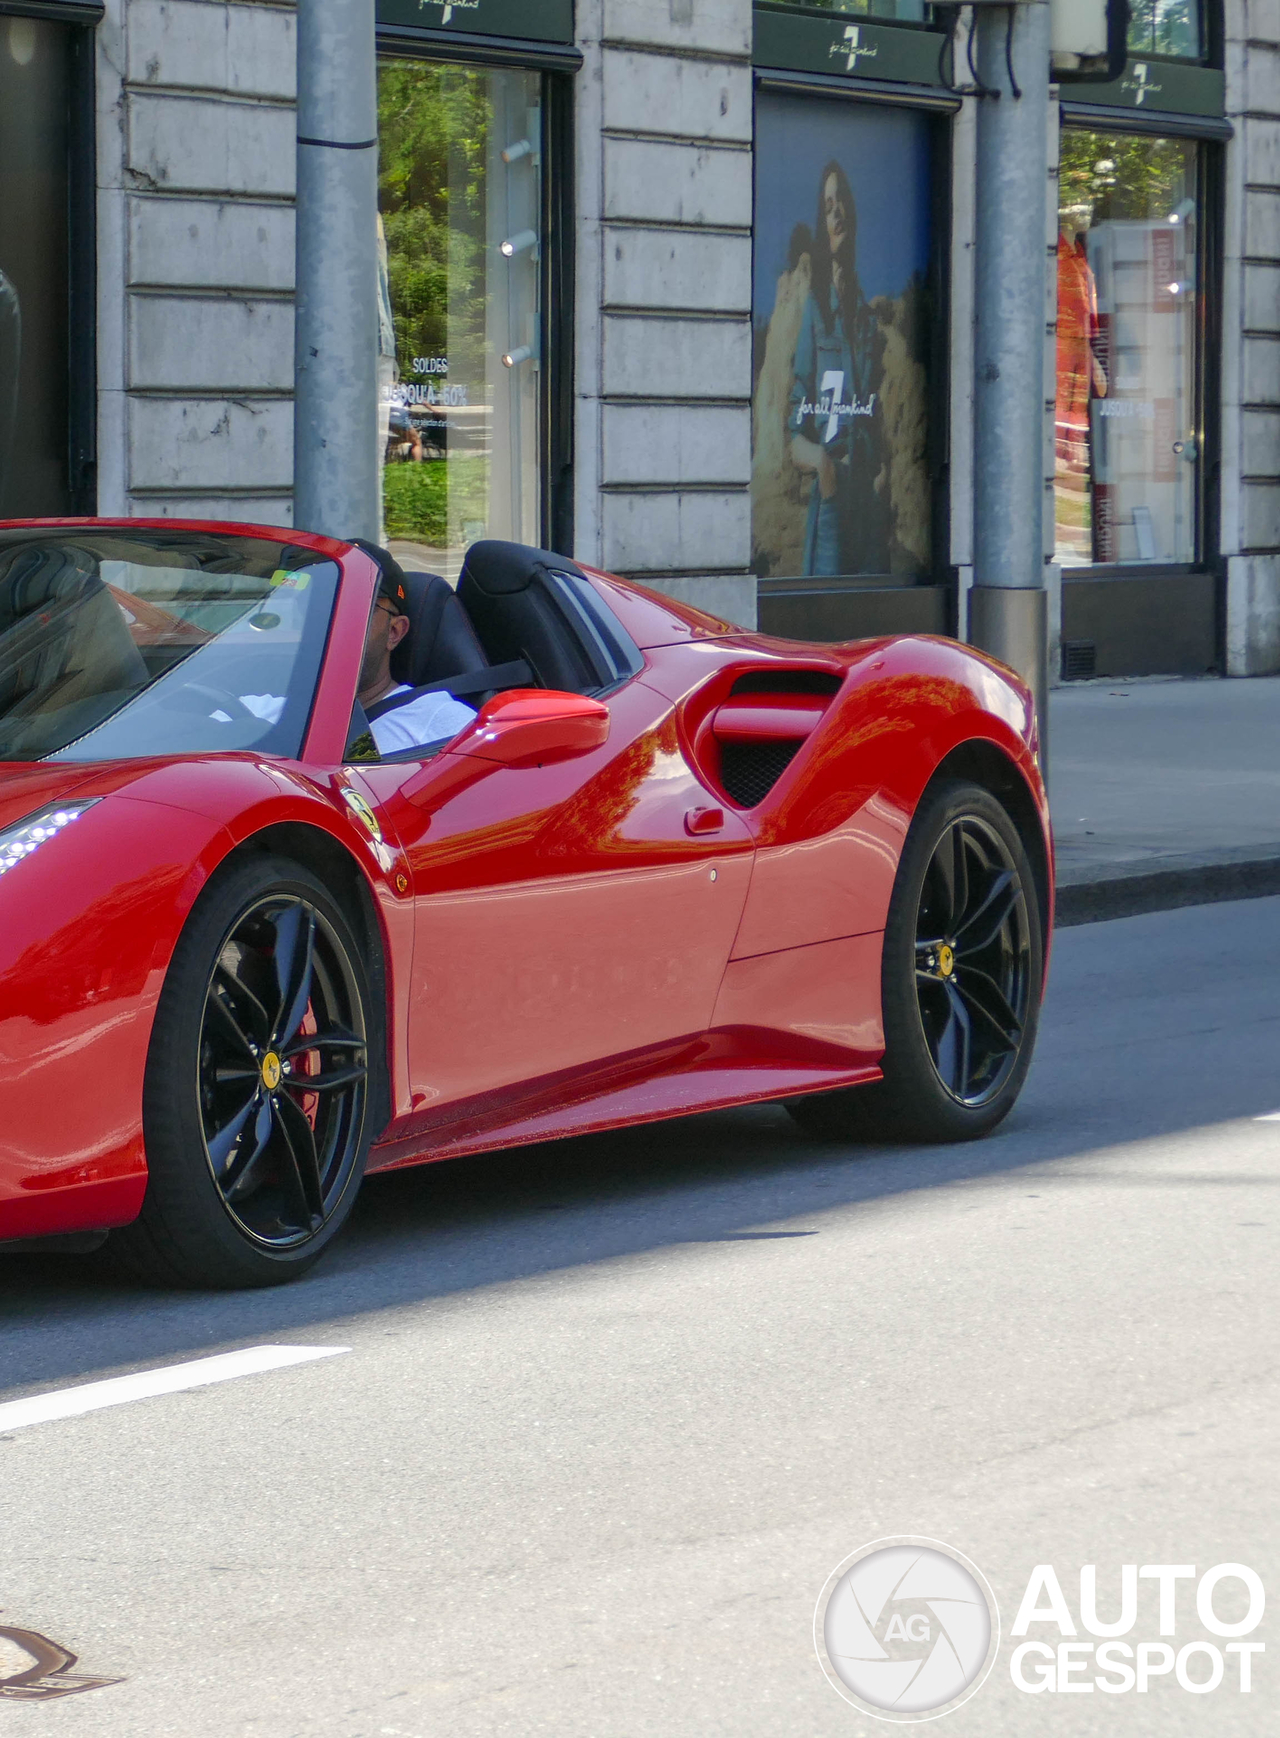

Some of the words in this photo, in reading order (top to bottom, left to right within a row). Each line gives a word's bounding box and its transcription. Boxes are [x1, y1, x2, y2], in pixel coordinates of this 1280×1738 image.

[412, 357, 448, 373] SOLDES
[796, 396, 814, 425] for
[814, 396, 830, 414] all
[820, 370, 845, 443] 7
